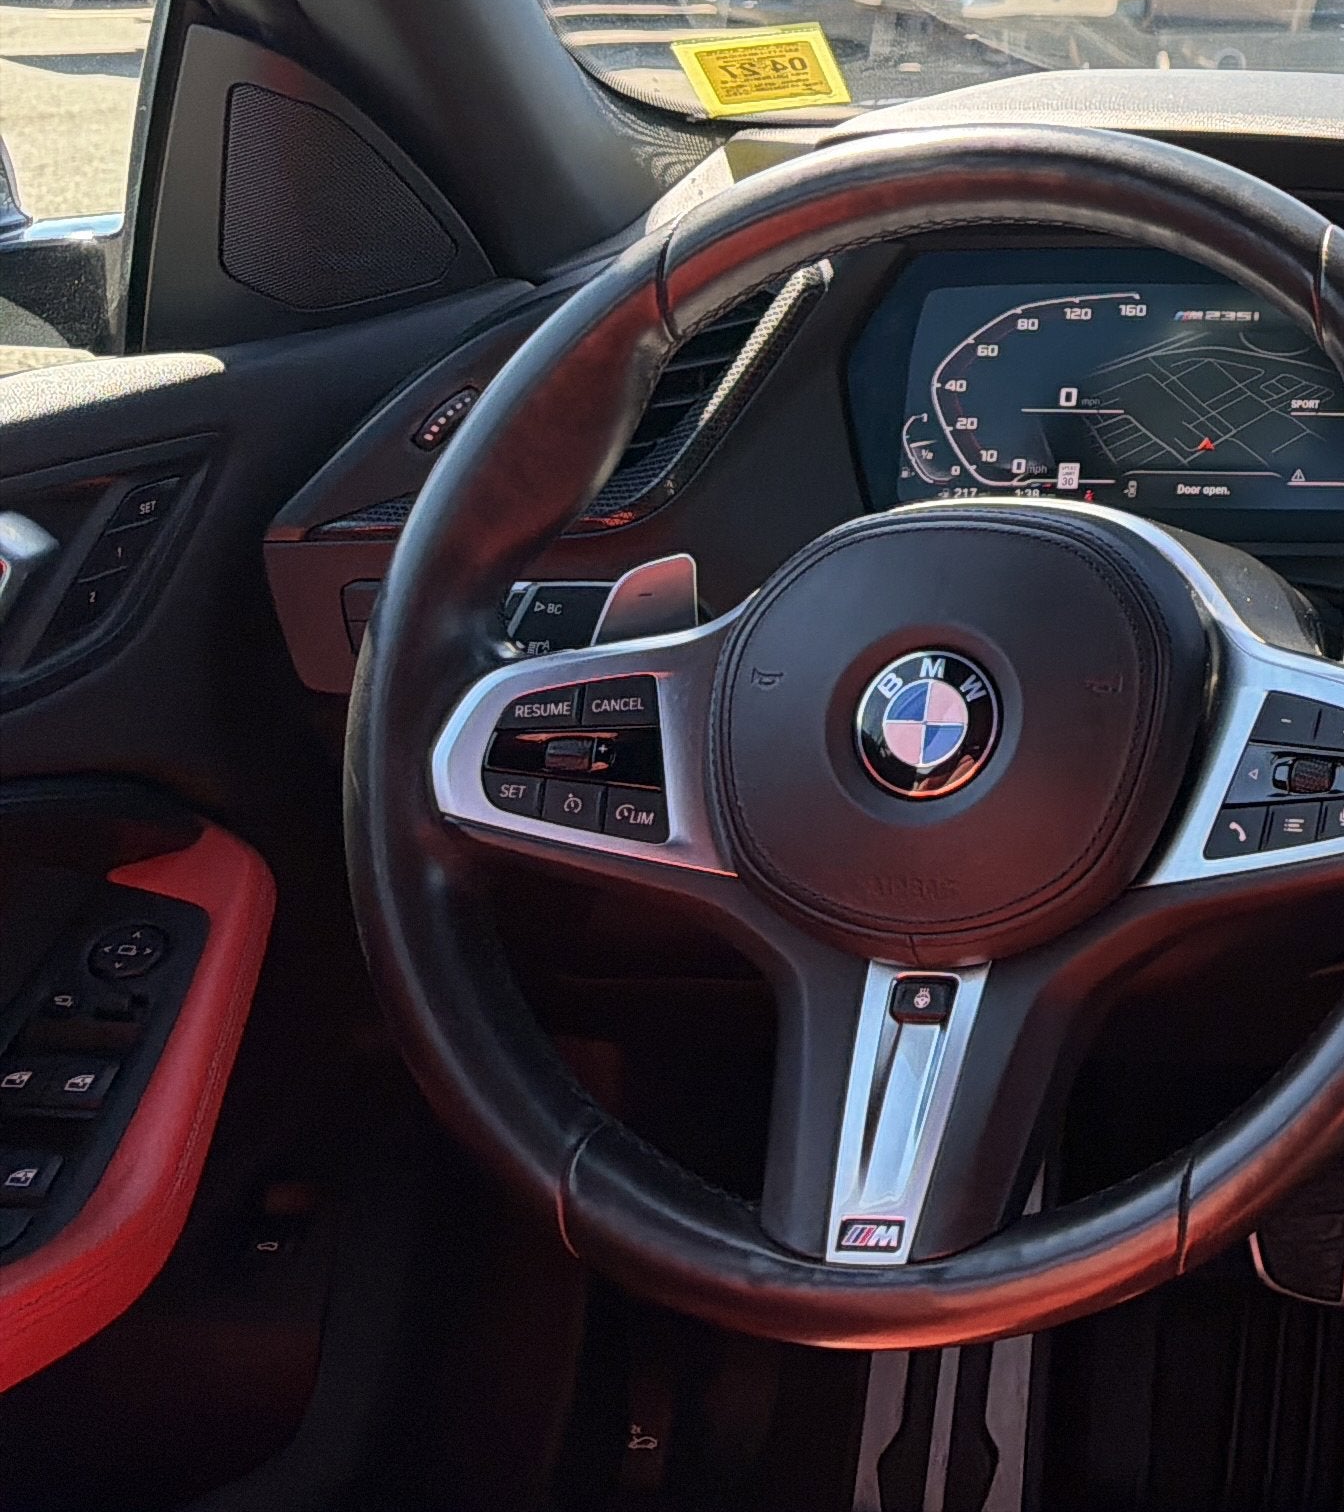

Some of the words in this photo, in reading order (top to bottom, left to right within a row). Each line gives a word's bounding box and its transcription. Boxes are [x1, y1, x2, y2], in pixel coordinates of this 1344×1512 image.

[1063, 308, 1092, 320] 120
[1119, 304, 1147, 317] 160
[1017, 318, 1039, 330] 80
[977, 344, 999, 357] 60
[944, 379, 967, 392] 40
[1059, 388, 1078, 407] 0
[1291, 399, 1320, 409] SPORT
[956, 417, 978, 430] 20
[979, 449, 998, 463] 10
[1012, 458, 1026, 473] 0
[1028, 463, 1048, 475] mph
[1061, 478, 1074, 487] 30
[1177, 484, 1200, 496] Door
[1203, 486, 1231, 498] open.
[139, 501, 156, 514] SET
[547, 604, 562, 615] BC
[877, 657, 987, 702] BMW
[515, 702, 571, 718] RESUME
[592, 698, 644, 713] CANCEL
[500, 784, 526, 799] SET
[629, 811, 655, 826] LIM
